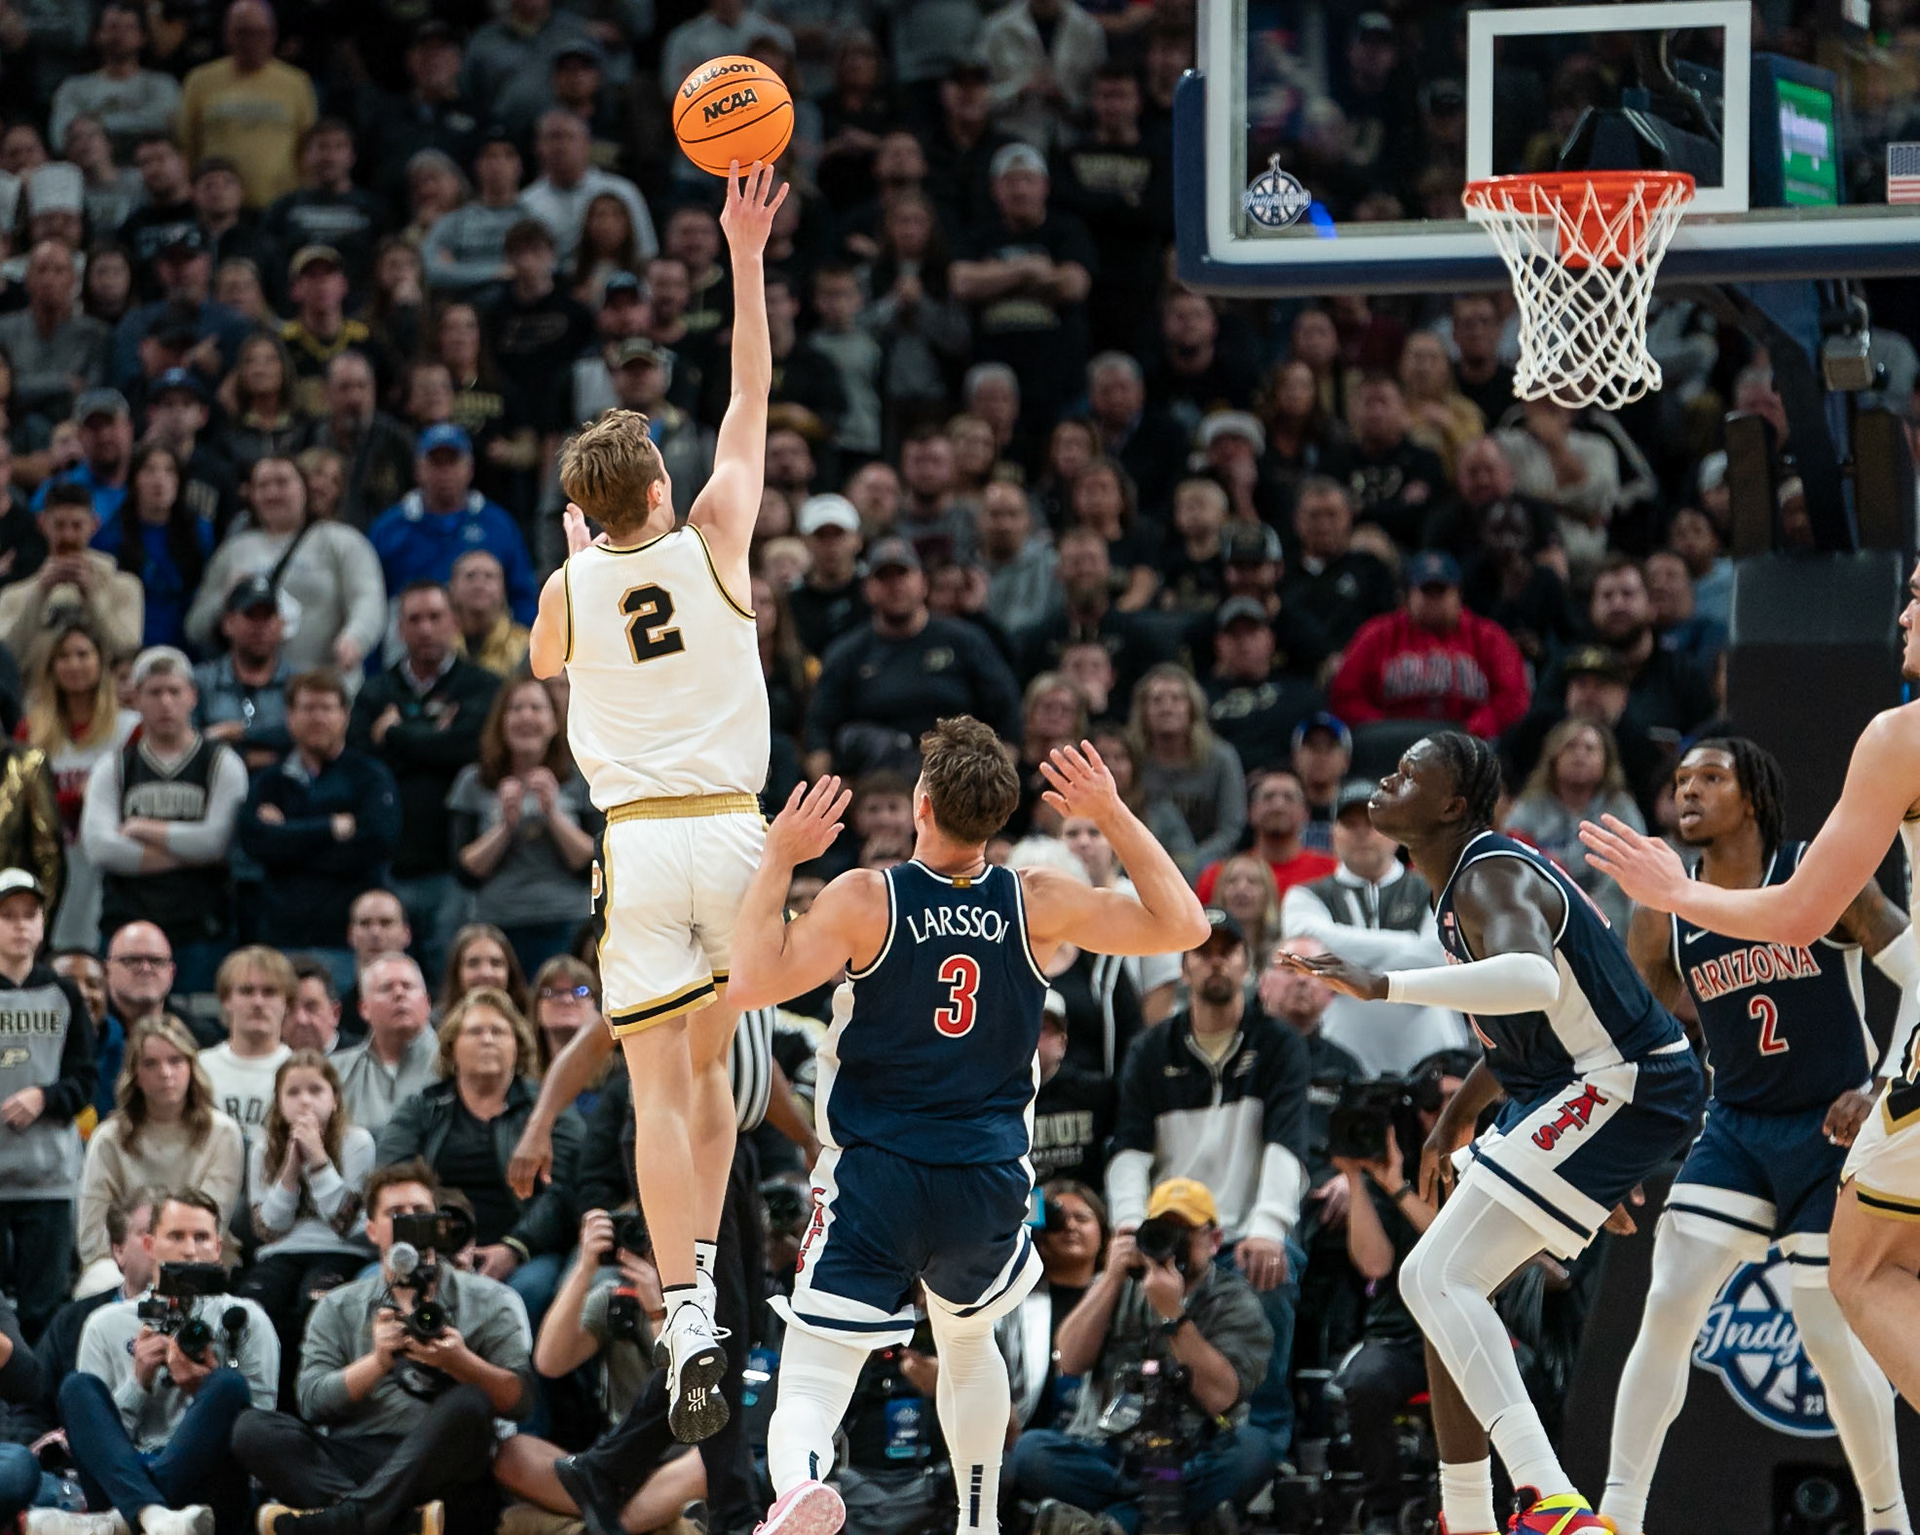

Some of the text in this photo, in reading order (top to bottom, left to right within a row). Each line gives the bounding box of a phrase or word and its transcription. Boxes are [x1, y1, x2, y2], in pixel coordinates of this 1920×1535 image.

[682, 63, 758, 99] Wilson
[702, 87, 759, 124] NCAA
[617, 581, 687, 666] 2
[933, 953, 981, 1038] 3
[1690, 943, 1822, 1002] ARIZONA
[1749, 994, 1790, 1056] 2
[1693, 1303, 1799, 1367] Indy
